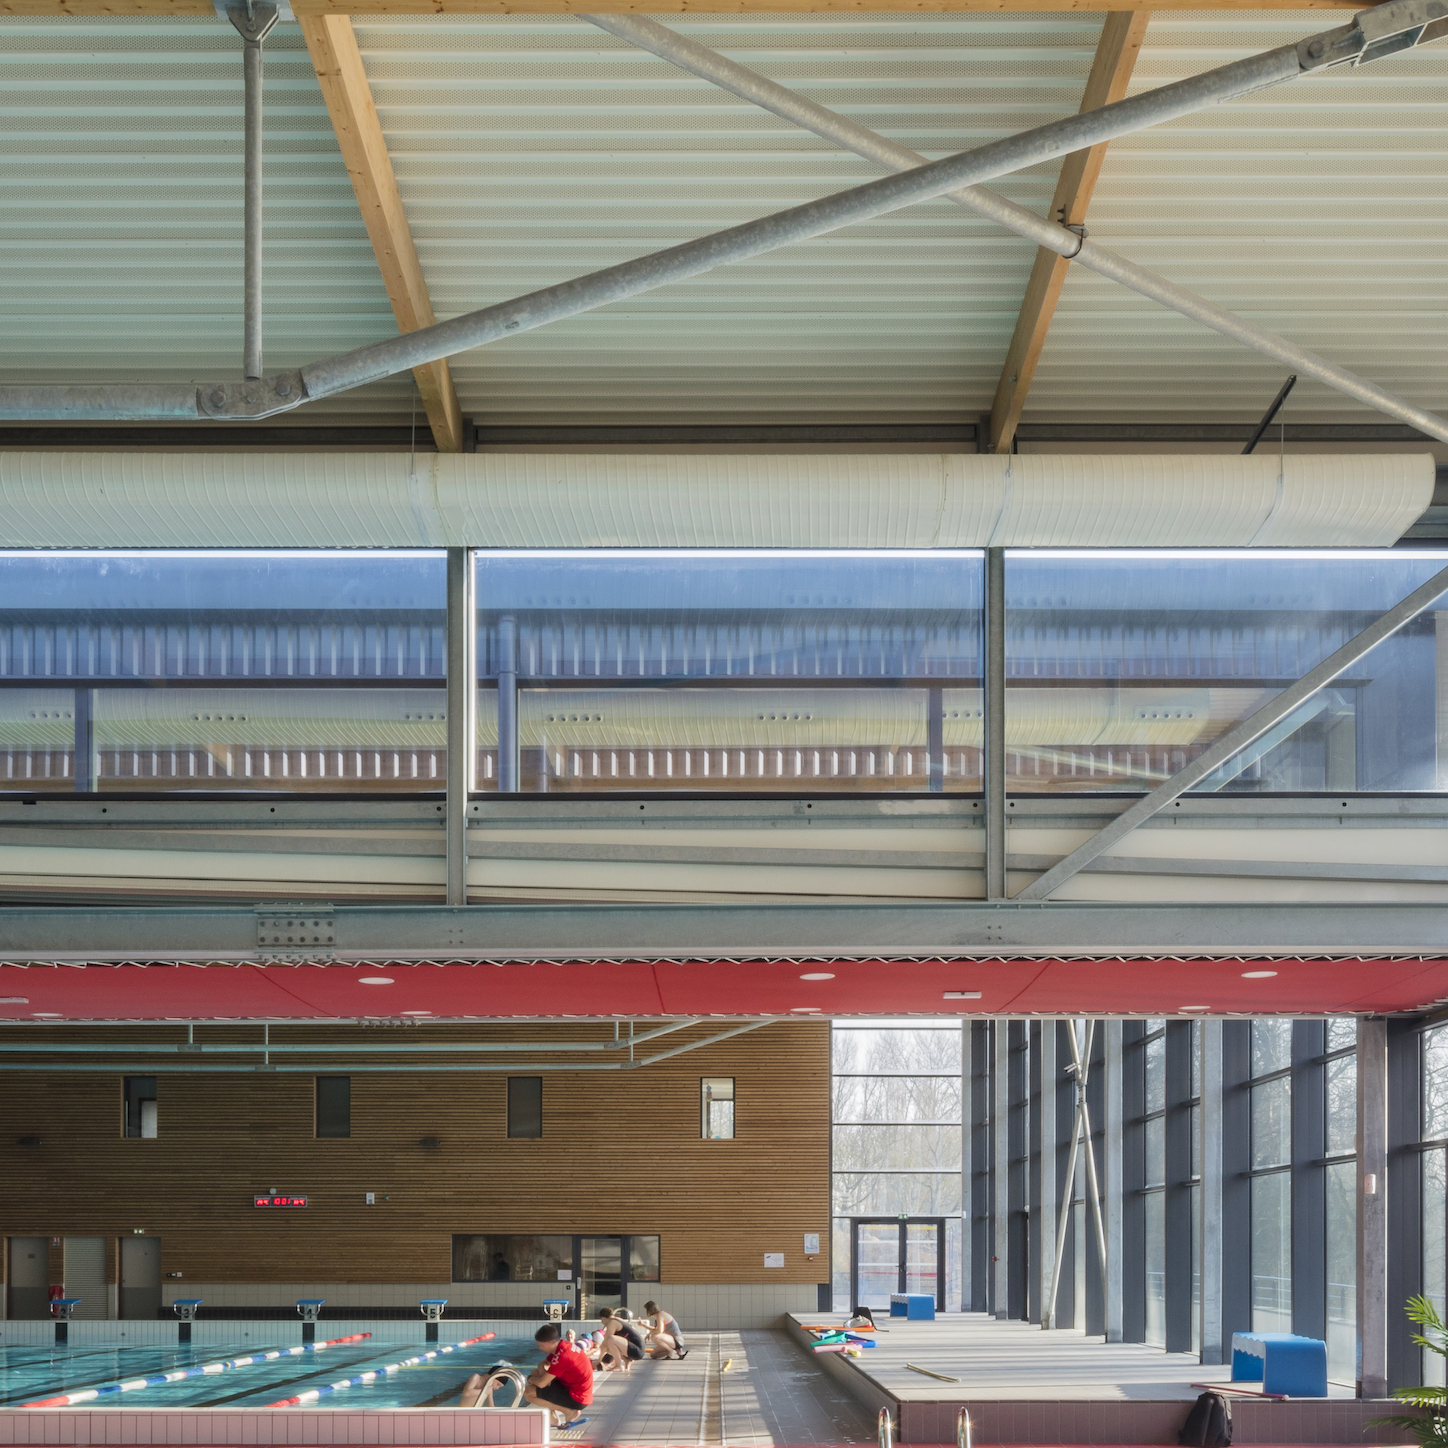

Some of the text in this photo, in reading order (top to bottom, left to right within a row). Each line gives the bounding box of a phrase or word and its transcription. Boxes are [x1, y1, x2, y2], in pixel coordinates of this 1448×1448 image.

[60, 1308, 66, 1318] 2
[183, 1308, 189, 1318] 3
[307, 1308, 312, 1318] 4
[430, 1308, 436, 1318] 5
[553, 1308, 559, 1318] 6
